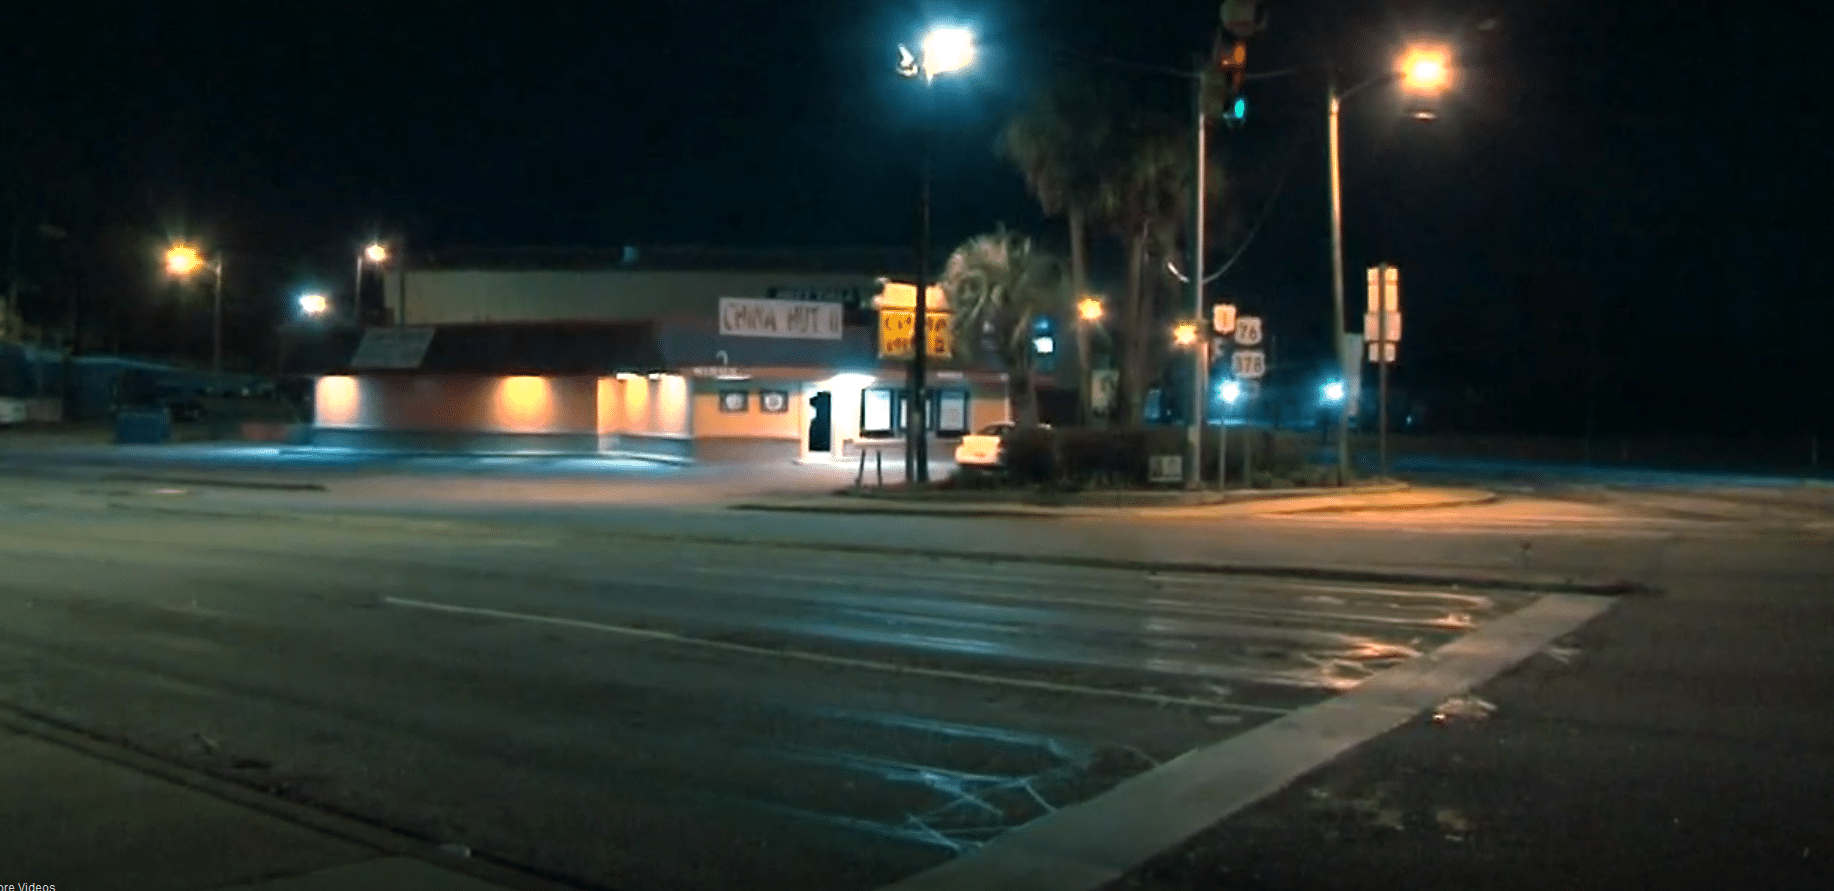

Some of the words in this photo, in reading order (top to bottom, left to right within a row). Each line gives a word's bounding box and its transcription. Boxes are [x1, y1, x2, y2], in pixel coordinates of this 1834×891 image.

[723, 303, 777, 331] CHINA
[786, 305, 819, 333] HUT
[1239, 321, 1258, 339] 76
[1235, 355, 1263, 374] 378
